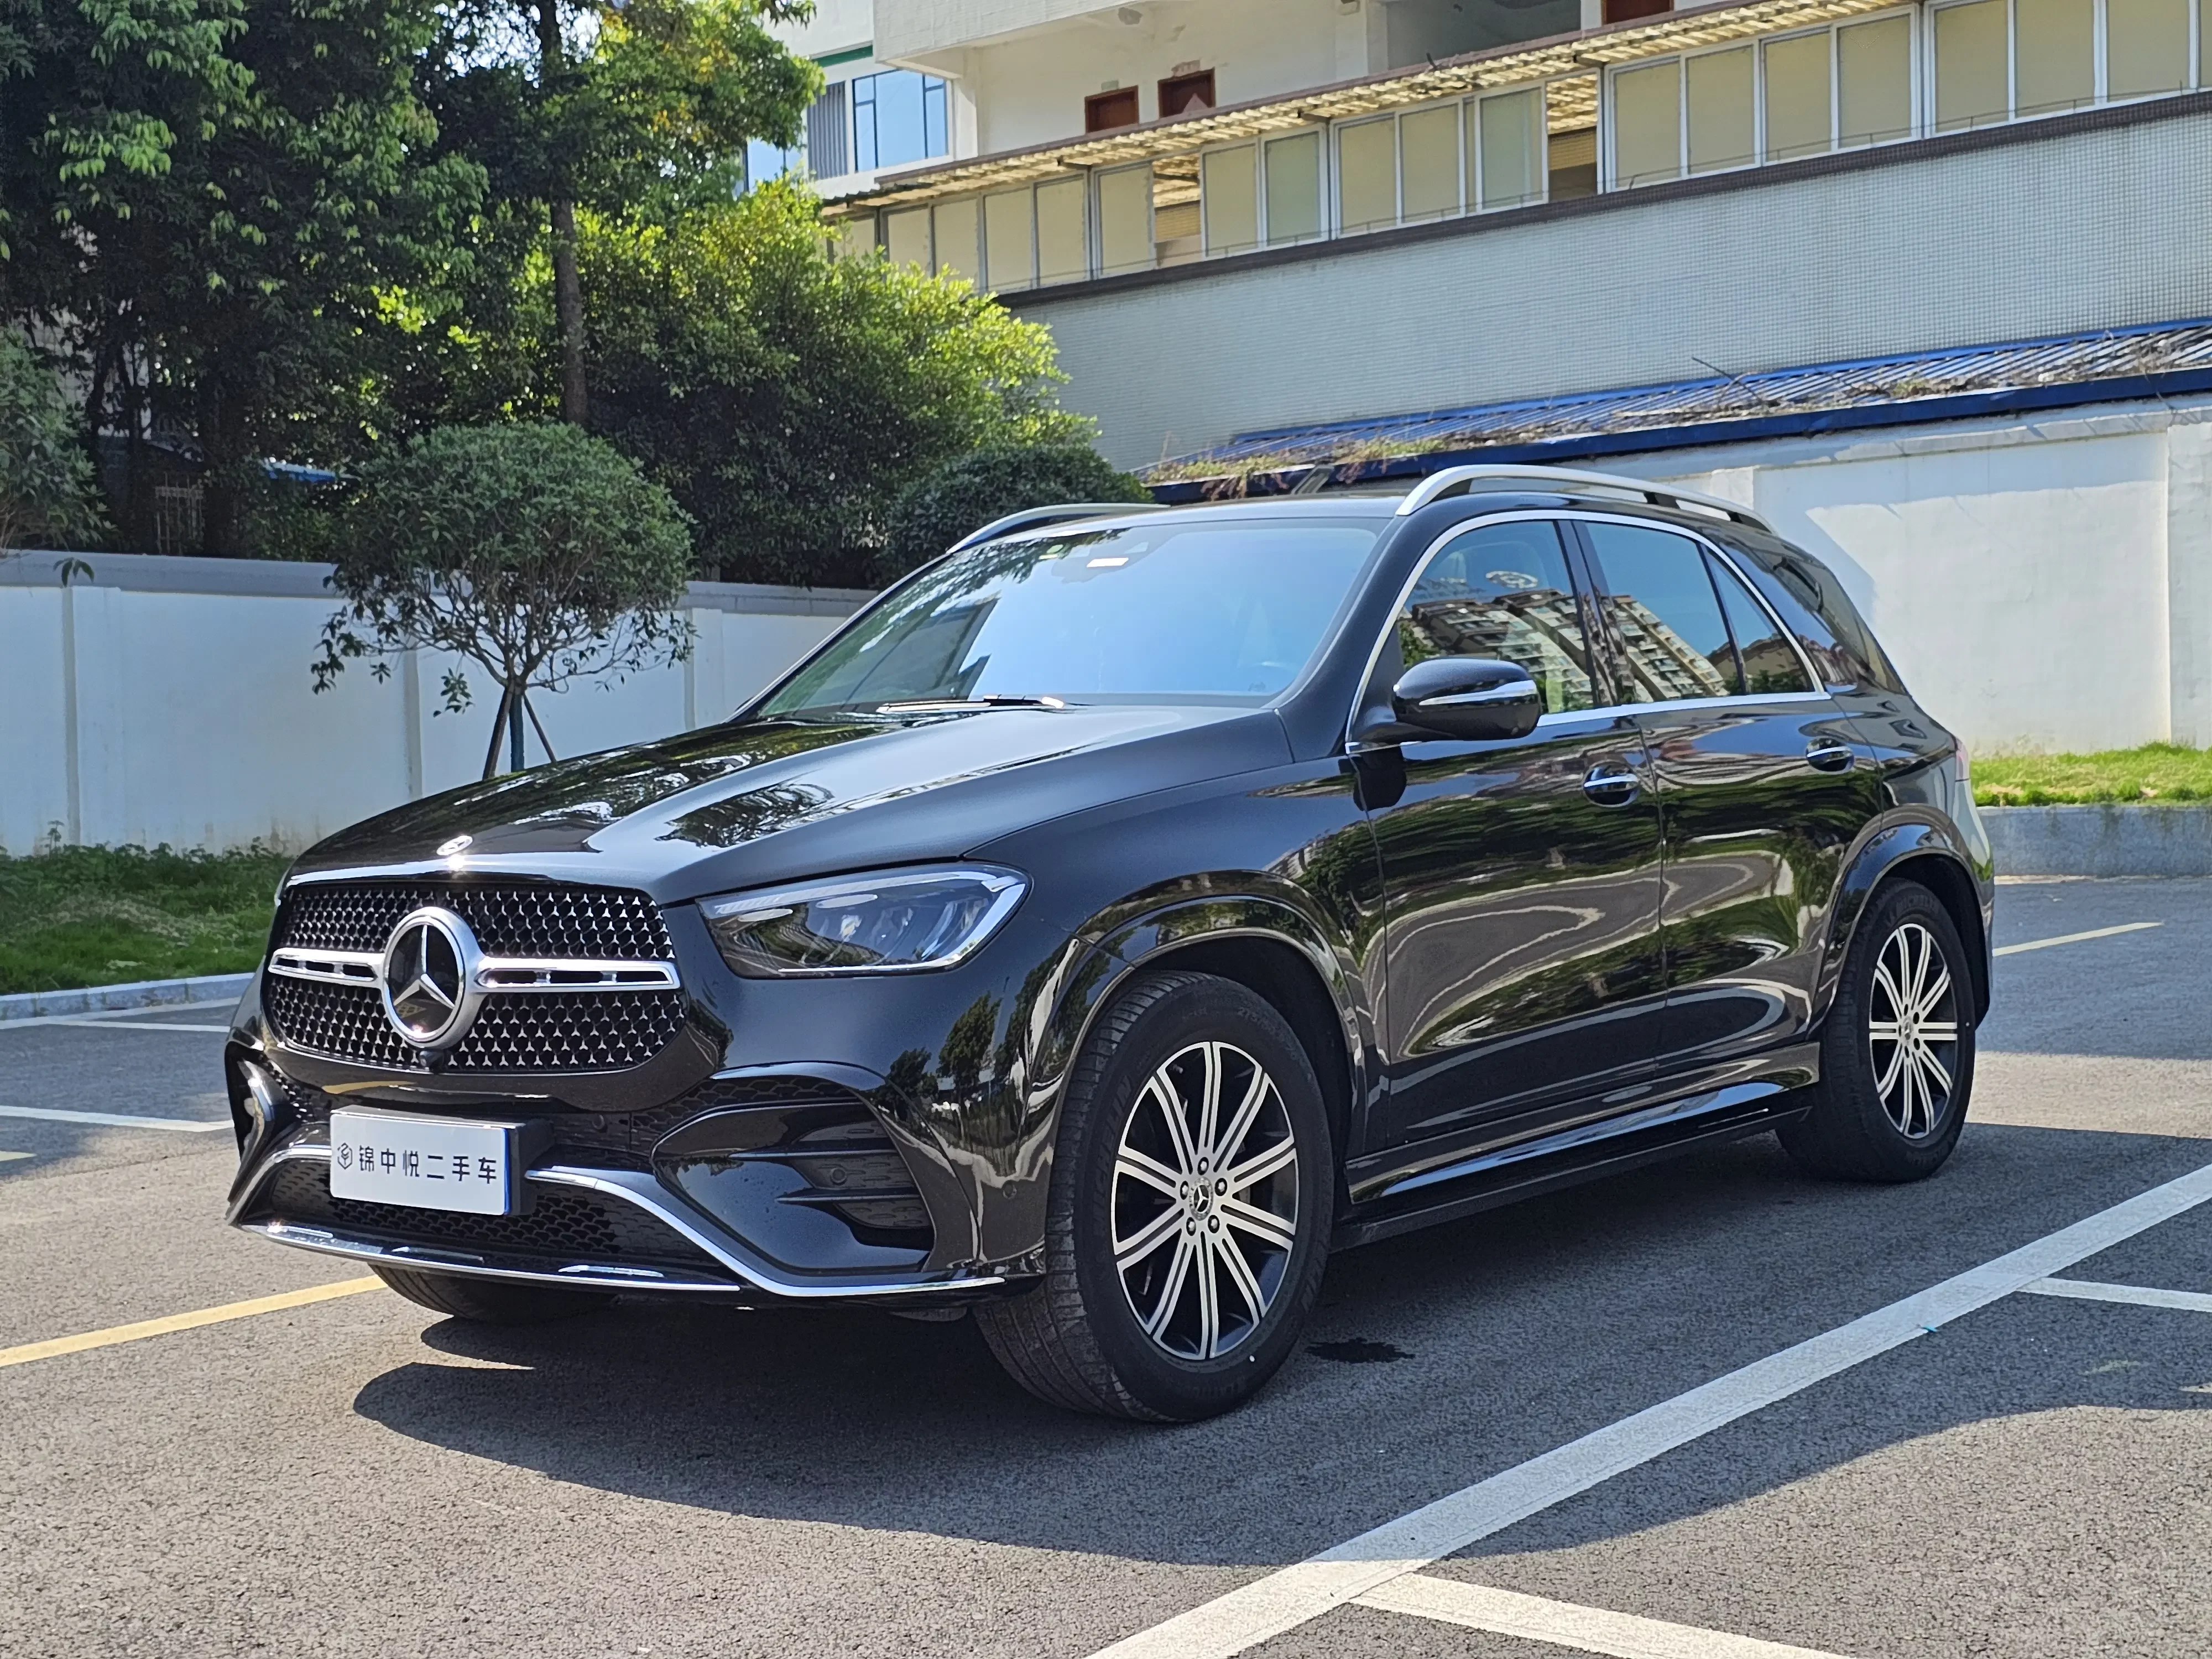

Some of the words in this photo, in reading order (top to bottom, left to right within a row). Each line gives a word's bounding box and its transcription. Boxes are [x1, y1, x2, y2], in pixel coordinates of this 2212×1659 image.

[359, 1145, 497, 1185] 锦中悦二手车
